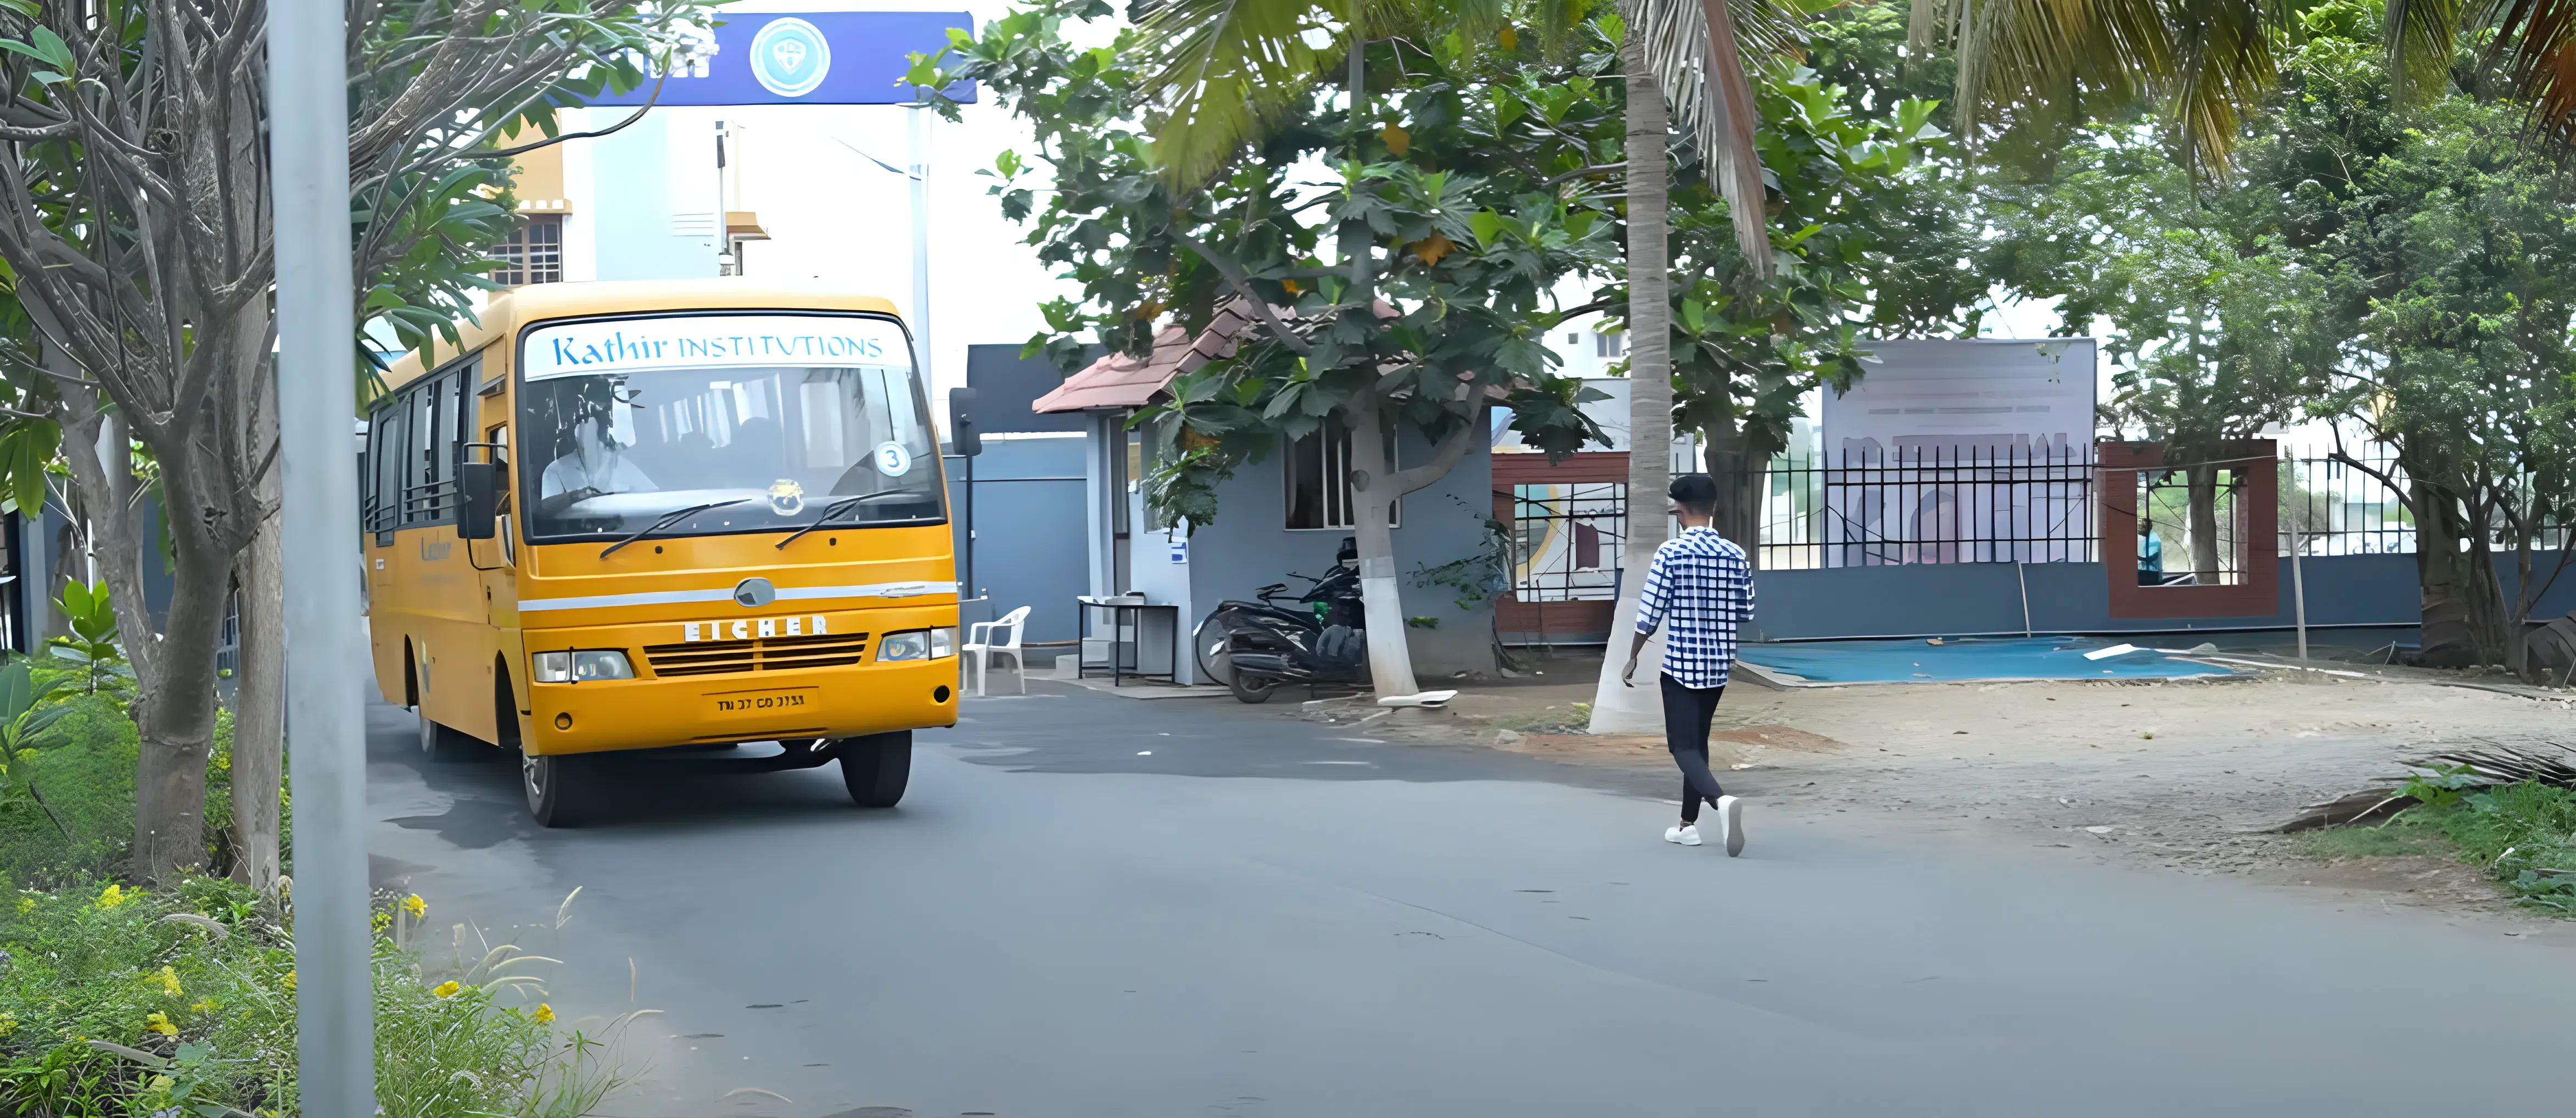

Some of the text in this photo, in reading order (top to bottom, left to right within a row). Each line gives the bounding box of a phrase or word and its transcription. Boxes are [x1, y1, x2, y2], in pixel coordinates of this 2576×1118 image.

[552, 331, 668, 366] Kathir
[885, 449, 900, 468] 3
[684, 615, 827, 642] EICHER
